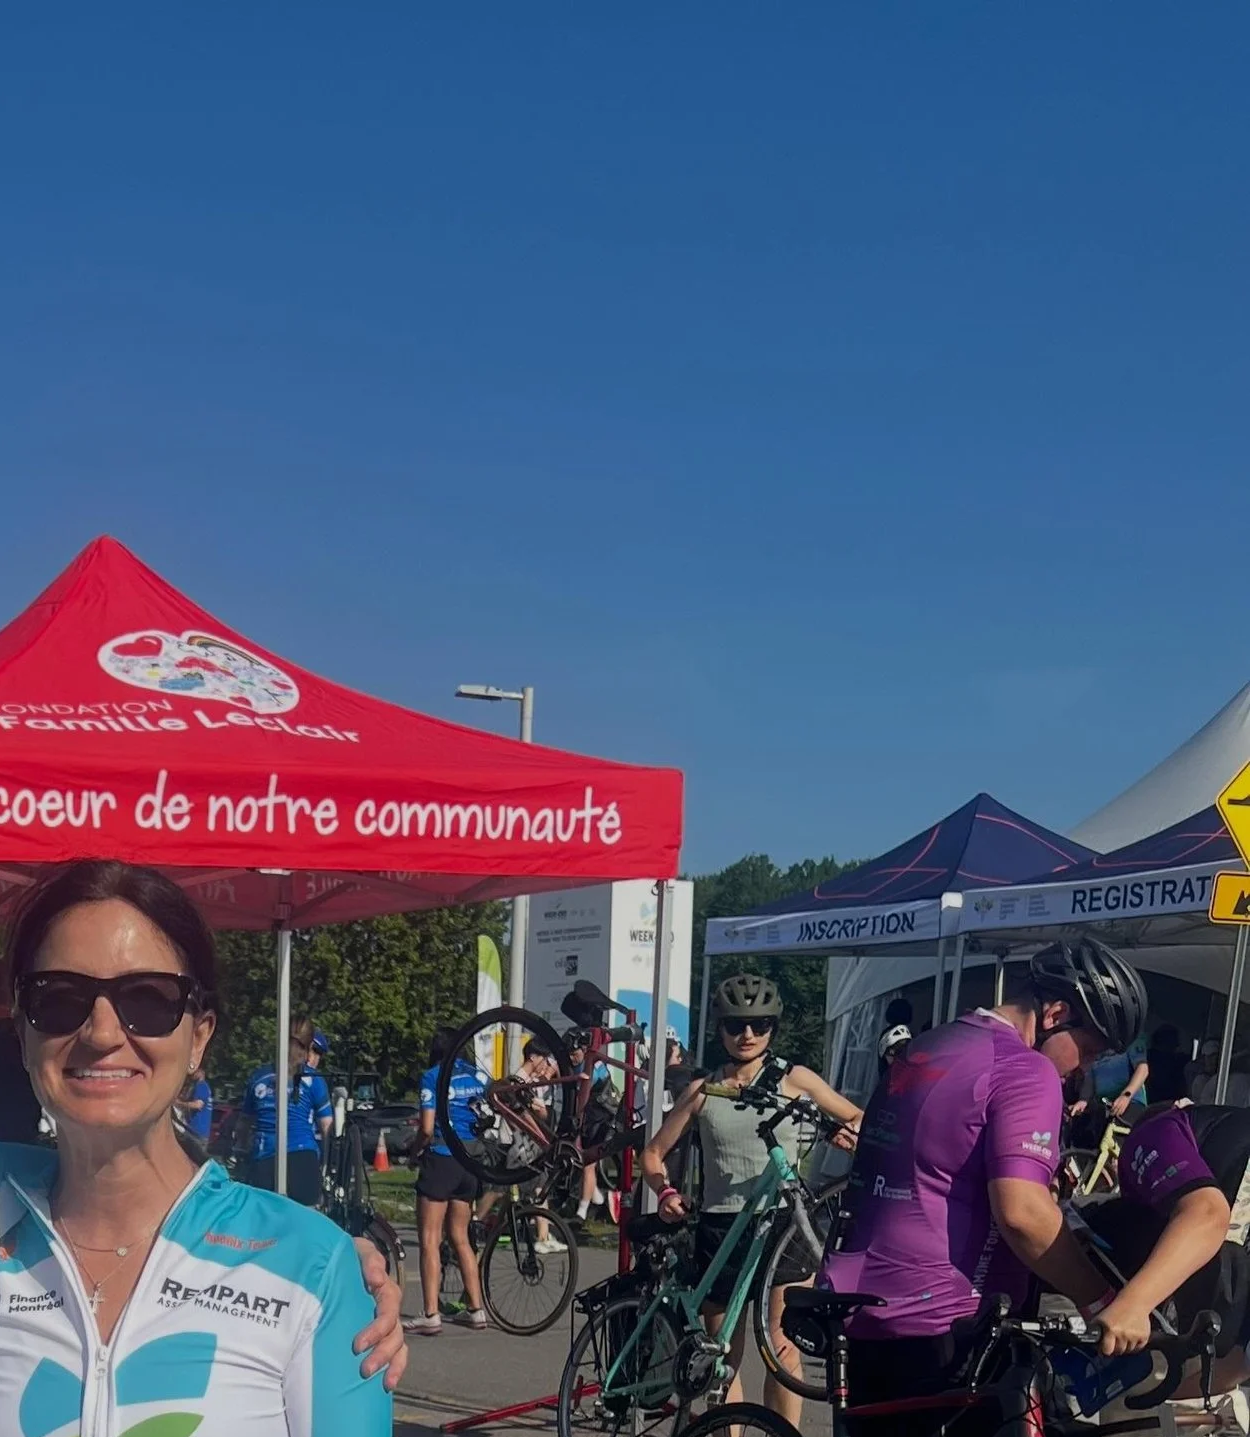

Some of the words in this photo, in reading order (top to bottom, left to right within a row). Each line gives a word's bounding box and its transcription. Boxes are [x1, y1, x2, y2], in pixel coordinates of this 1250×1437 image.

[193, 708, 361, 744] Leclair
[135, 769, 195, 832] de
[207, 773, 340, 836] notre
[354, 785, 623, 846] communauté
[1070, 875, 1212, 915] REGISTRAT
[797, 912, 917, 943] INSCRIPTION
[8, 1295, 65, 1314] Montréal
[10, 1289, 57, 1304] Finance
[157, 1297, 190, 1309] ASS
[194, 1297, 280, 1329] MANAGEMENT
[160, 1277, 291, 1319] REMPART
